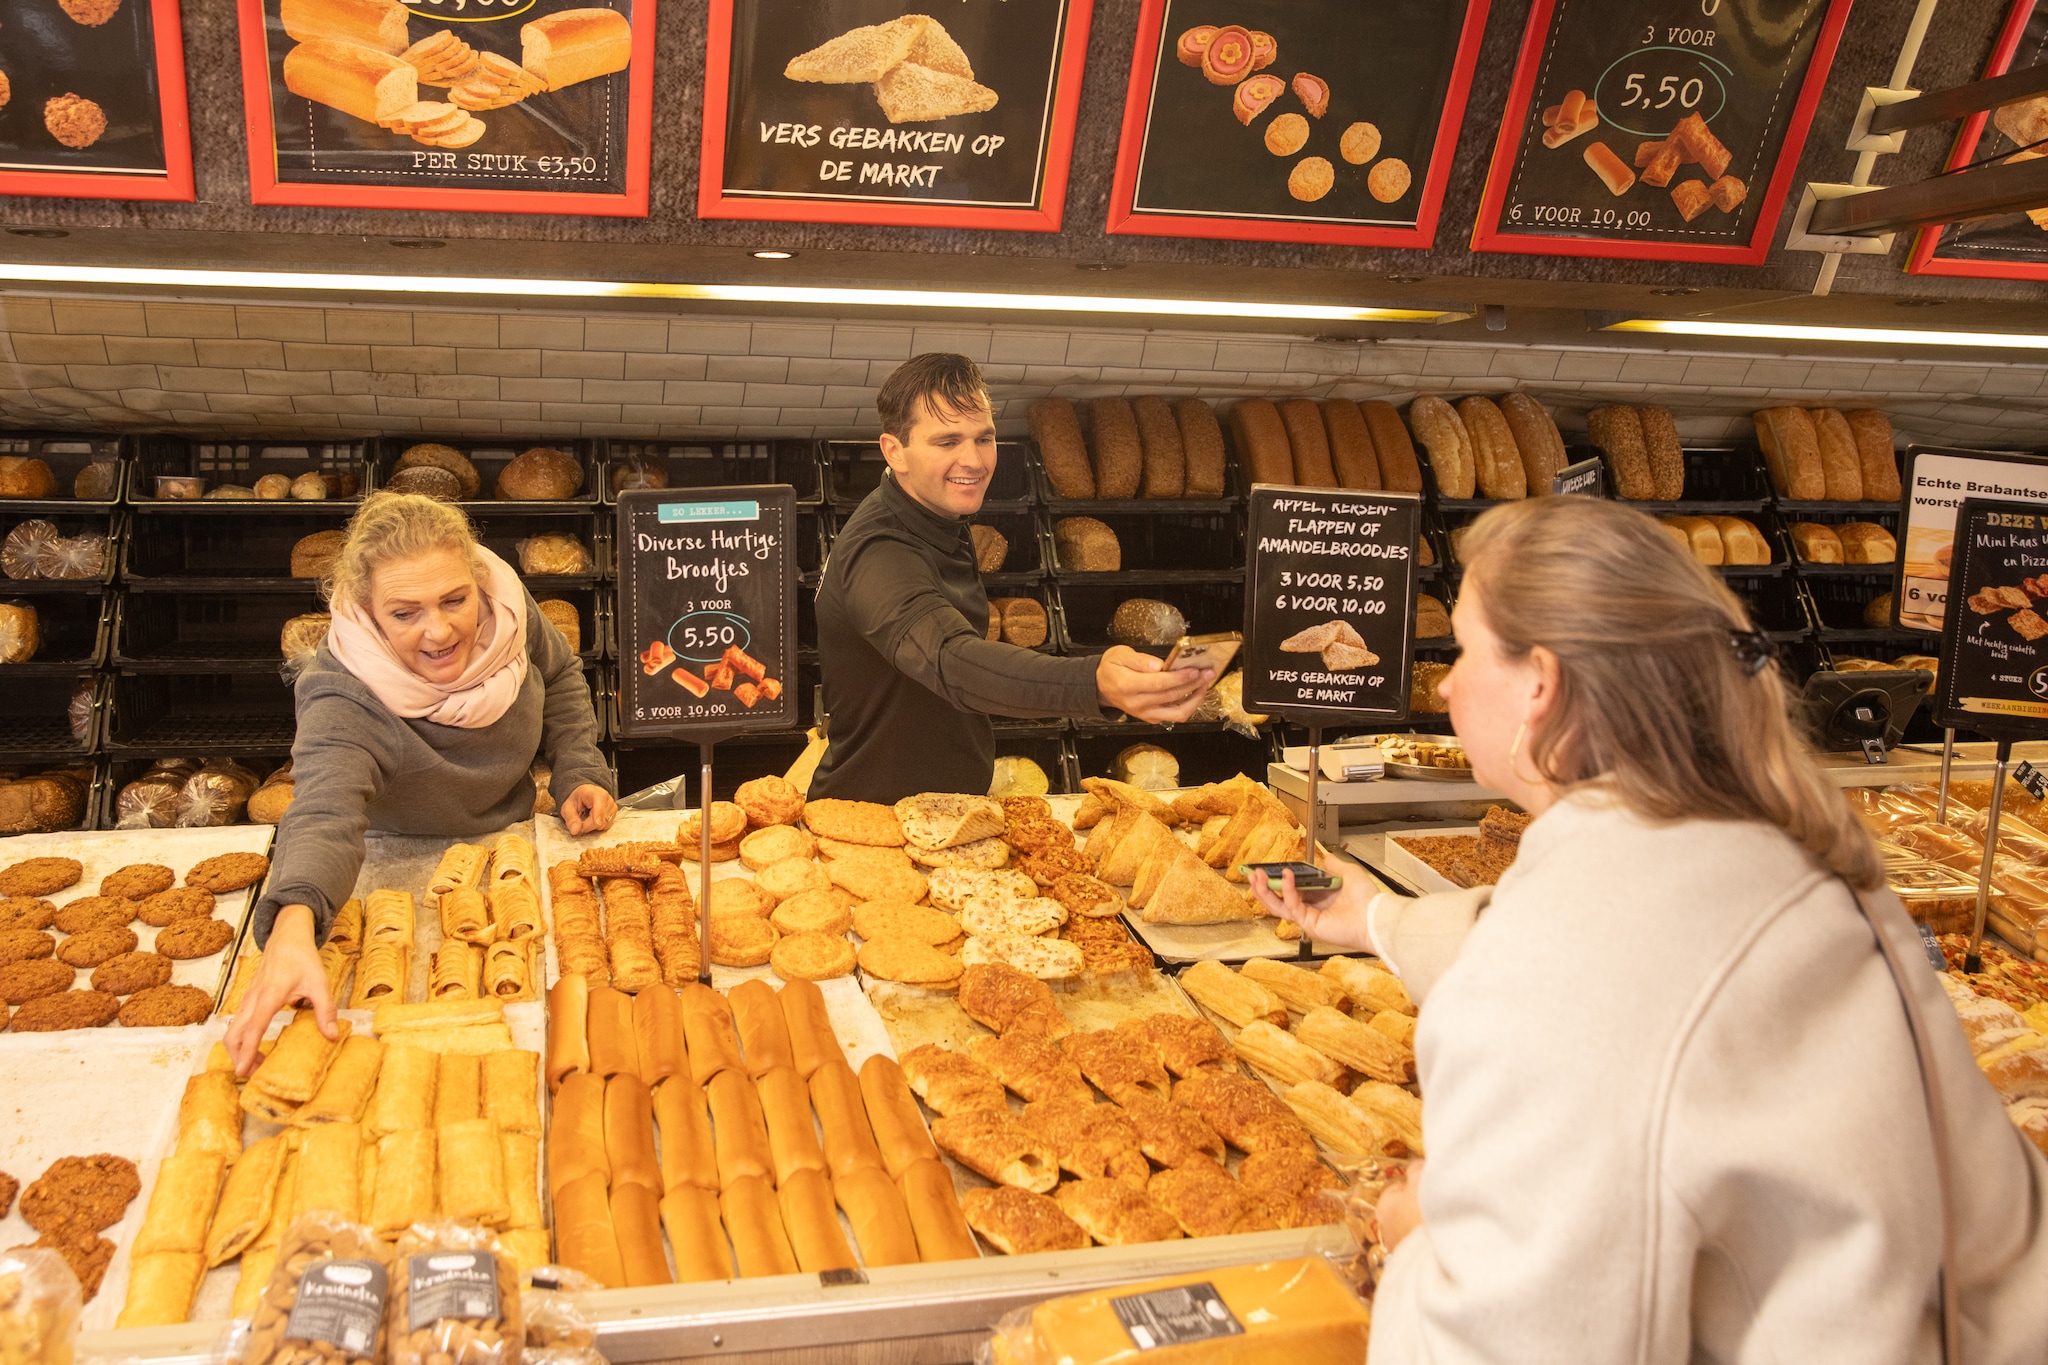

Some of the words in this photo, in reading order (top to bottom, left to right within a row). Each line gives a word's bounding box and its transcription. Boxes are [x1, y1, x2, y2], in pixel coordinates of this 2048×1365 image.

[1642, 25, 1655, 44] 3
[1668, 27, 1716, 47] VOOR
[1620, 72, 1705, 112] 5,50
[760, 122, 821, 147] VERS
[829, 126, 964, 154] GEBAKKEN
[970, 134, 1005, 157] OP
[412, 151, 457, 171] PER
[467, 153, 528, 173] STUK
[537, 155, 597, 176] €3,50
[820, 159, 852, 183] DE
[859, 162, 943, 189] MARKT
[1511, 203, 1523, 221] 6
[1534, 204, 1582, 225] VOOR
[1591, 208, 1651, 228] 10,00
[1917, 476, 1961, 490] Echte
[1966, 481, 2048, 499] Brabantse
[672, 507, 685, 517] ZO
[1273, 499, 1326, 514] APPEL,
[1288, 519, 1355, 536] FLAPPEN
[1360, 523, 1381, 537] OF
[1986, 512, 2035, 529] DEZE
[638, 532, 705, 552] Diverse
[711, 528, 778, 560] Hartige
[1258, 537, 1409, 560] AMANDELBROODJES
[1976, 534, 2006, 548] Mini
[2009, 533, 2038, 549] Kaas
[2003, 558, 2018, 567] en
[2021, 553, 2048, 567] Pizz
[666, 556, 750, 593] Broodjes
[1280, 571, 1292, 587] 3
[1296, 572, 1343, 591] VOOR
[1347, 575, 1384, 591] 5,50
[1909, 588, 1920, 600] 6
[687, 601, 694, 612] 3
[700, 599, 732, 611] VOOR
[1276, 594, 1287, 609] 6
[1292, 595, 1338, 614] VOOR
[1342, 598, 1386, 615] 10,00
[684, 625, 735, 648] 5,50
[1967, 635, 1983, 646] Met
[1269, 670, 1298, 683] VERS
[1301, 671, 1364, 686] GEBAKKEN
[1368, 676, 1385, 687] OP
[1999, 674, 2023, 683] STUKS
[1297, 689, 1313, 699] DE
[1316, 689, 1356, 703] MARKT
[637, 708, 644, 718] 6
[651, 705, 682, 716] VOOR
[688, 704, 727, 717] 10,00
[1981, 702, 2048, 714] WEEKAANBIEDIN
